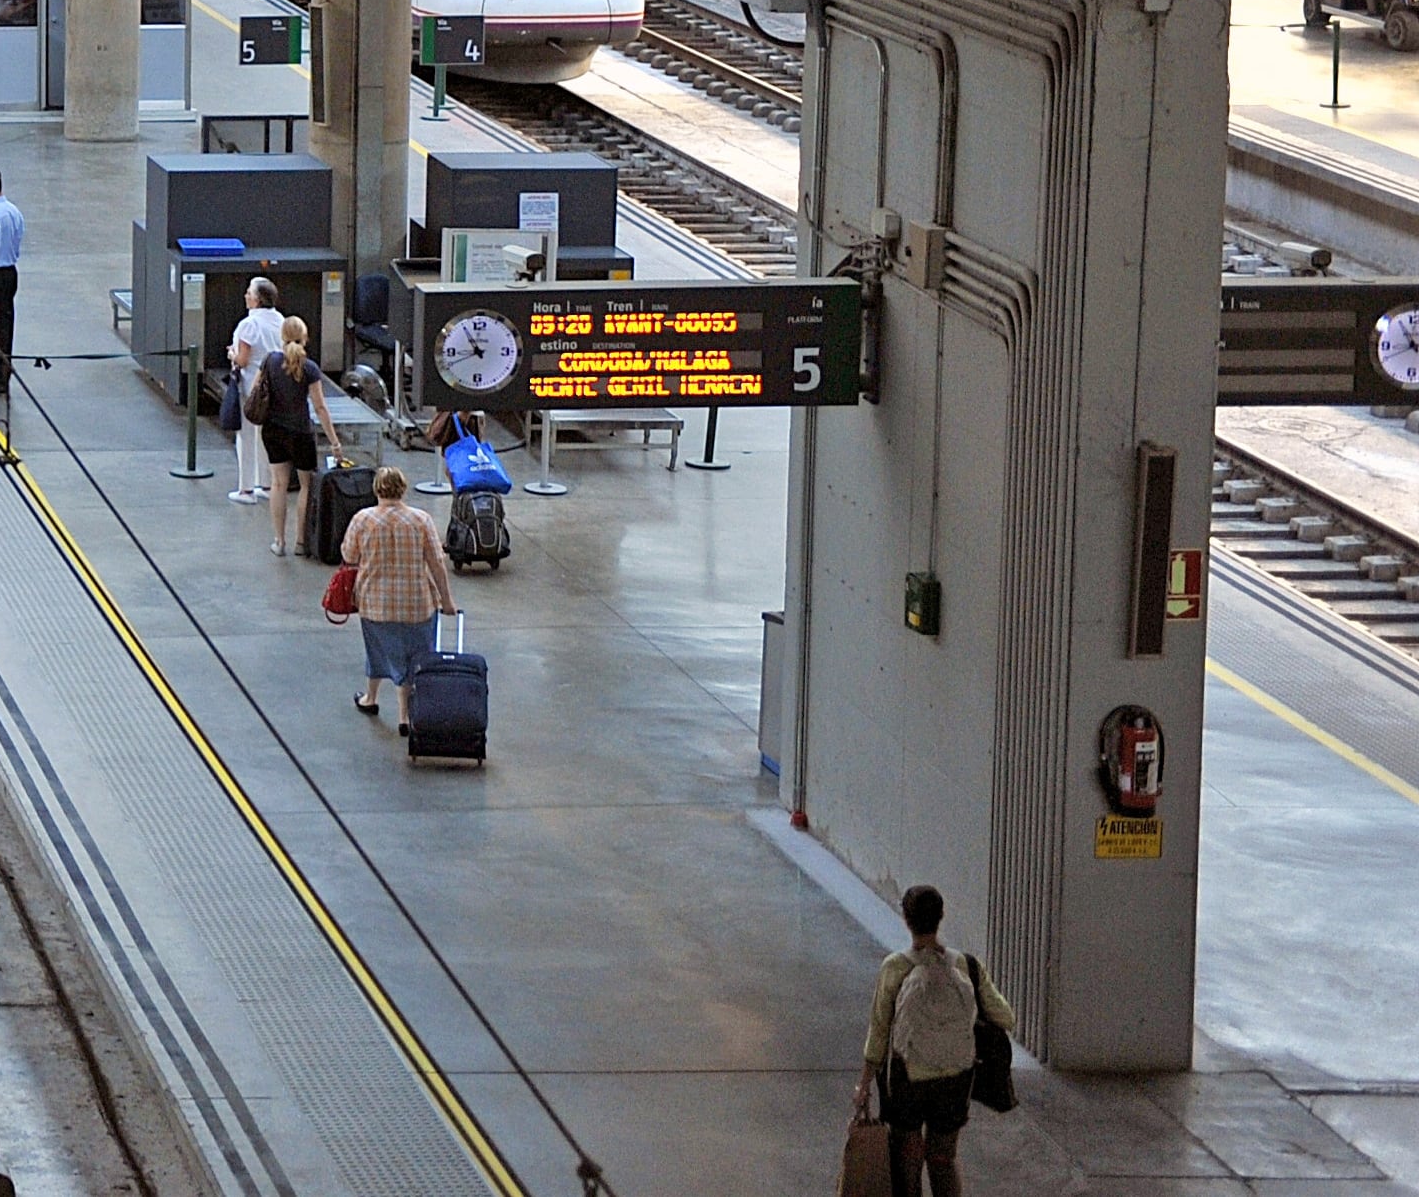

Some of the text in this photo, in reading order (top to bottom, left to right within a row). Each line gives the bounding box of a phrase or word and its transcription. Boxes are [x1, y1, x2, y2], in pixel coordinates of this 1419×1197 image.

[243, 40, 255, 63] 5
[465, 38, 481, 62] 4
[533, 302, 561, 314] Hora
[607, 301, 633, 312] Tren
[472, 321, 487, 331] 12
[447, 347, 456, 357] 9
[501, 347, 510, 357] 3
[793, 347, 821, 392] 5
[473, 373, 483, 383] 6
